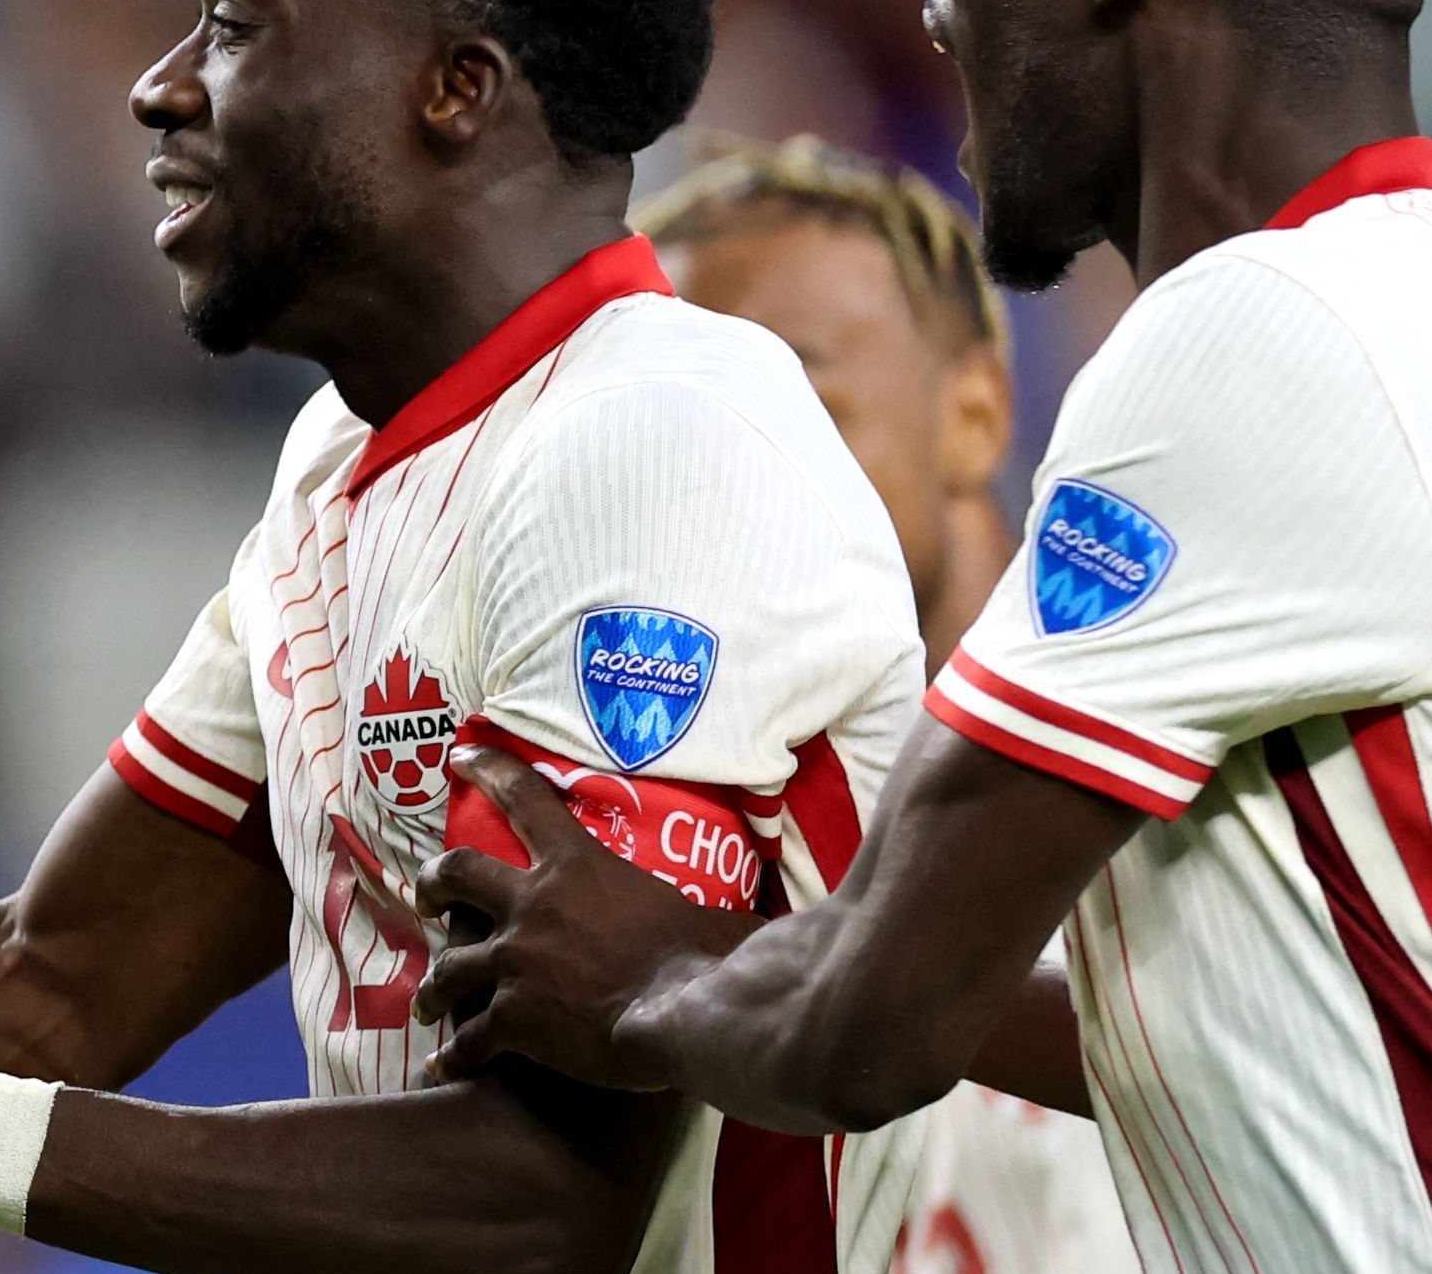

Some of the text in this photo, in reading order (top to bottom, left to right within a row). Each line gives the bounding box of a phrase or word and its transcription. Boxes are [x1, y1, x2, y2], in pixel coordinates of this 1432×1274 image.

[1047, 518, 1146, 582] ROCKING
[586, 669, 696, 697] THE CONTINENT
[590, 648, 700, 684] ROCKING
[358, 713, 457, 746] CANADA
[661, 810, 763, 901] CHOO
